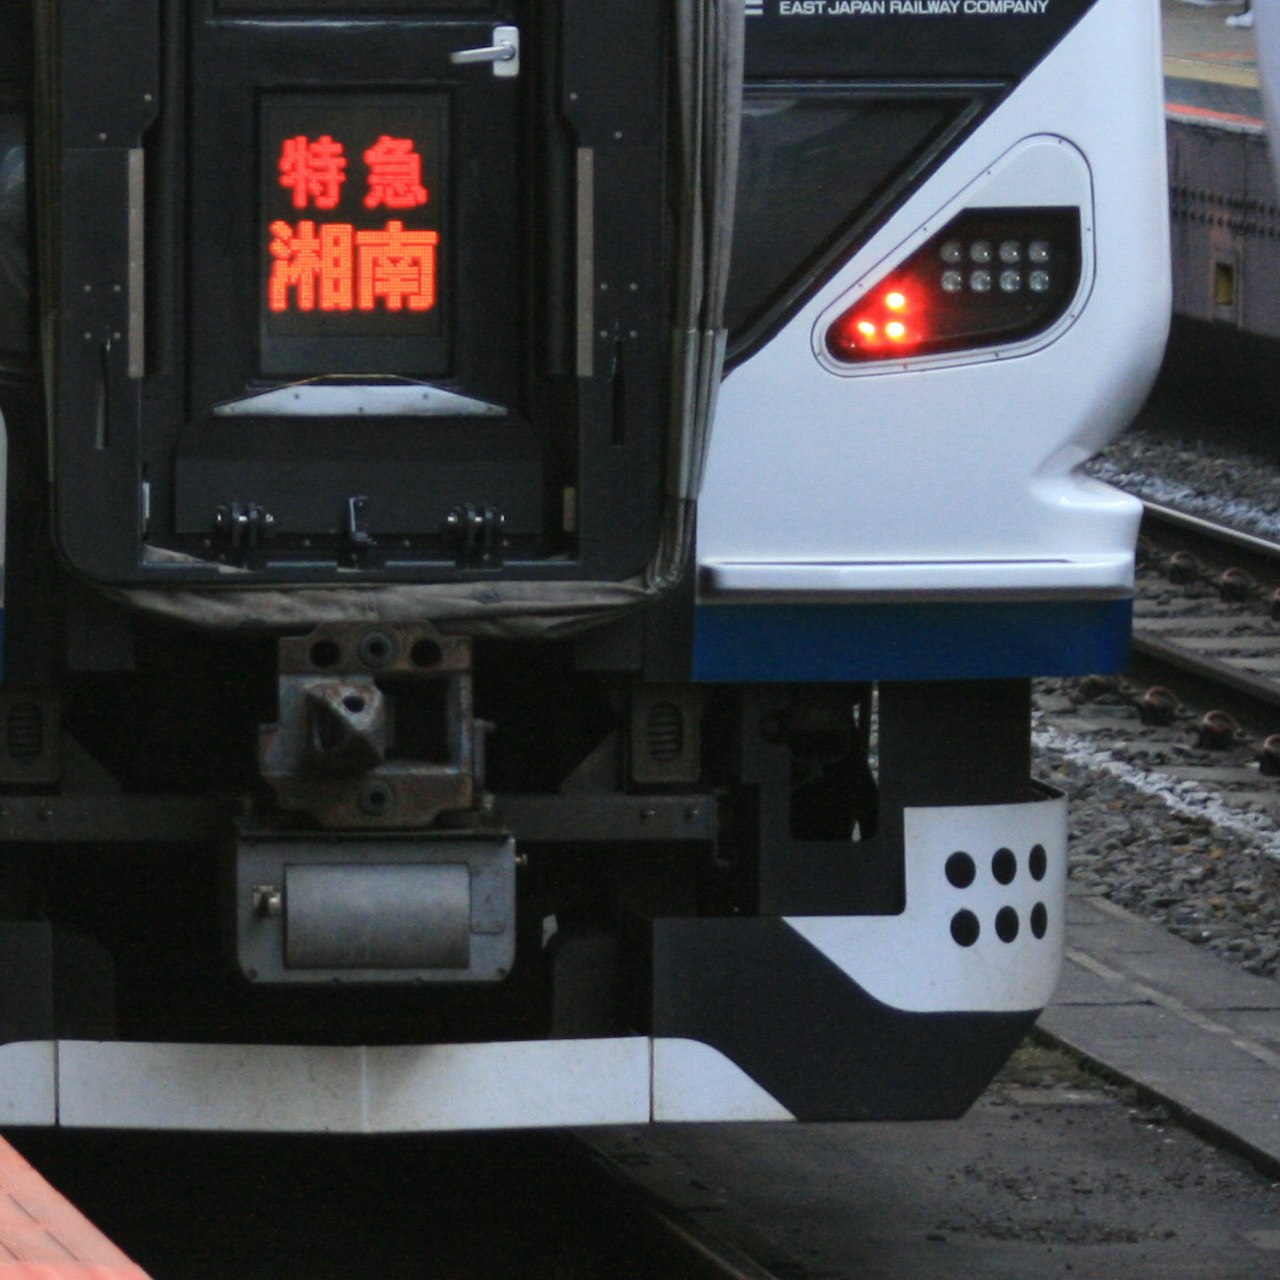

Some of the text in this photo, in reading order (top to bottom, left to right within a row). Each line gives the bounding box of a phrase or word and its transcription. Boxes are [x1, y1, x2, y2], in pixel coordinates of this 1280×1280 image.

[779, 0, 1050, 15] EAST JAPAN RAILWAY COMPANY
[278, 135, 429, 209] 特急
[269, 219, 440, 312] 湘南
